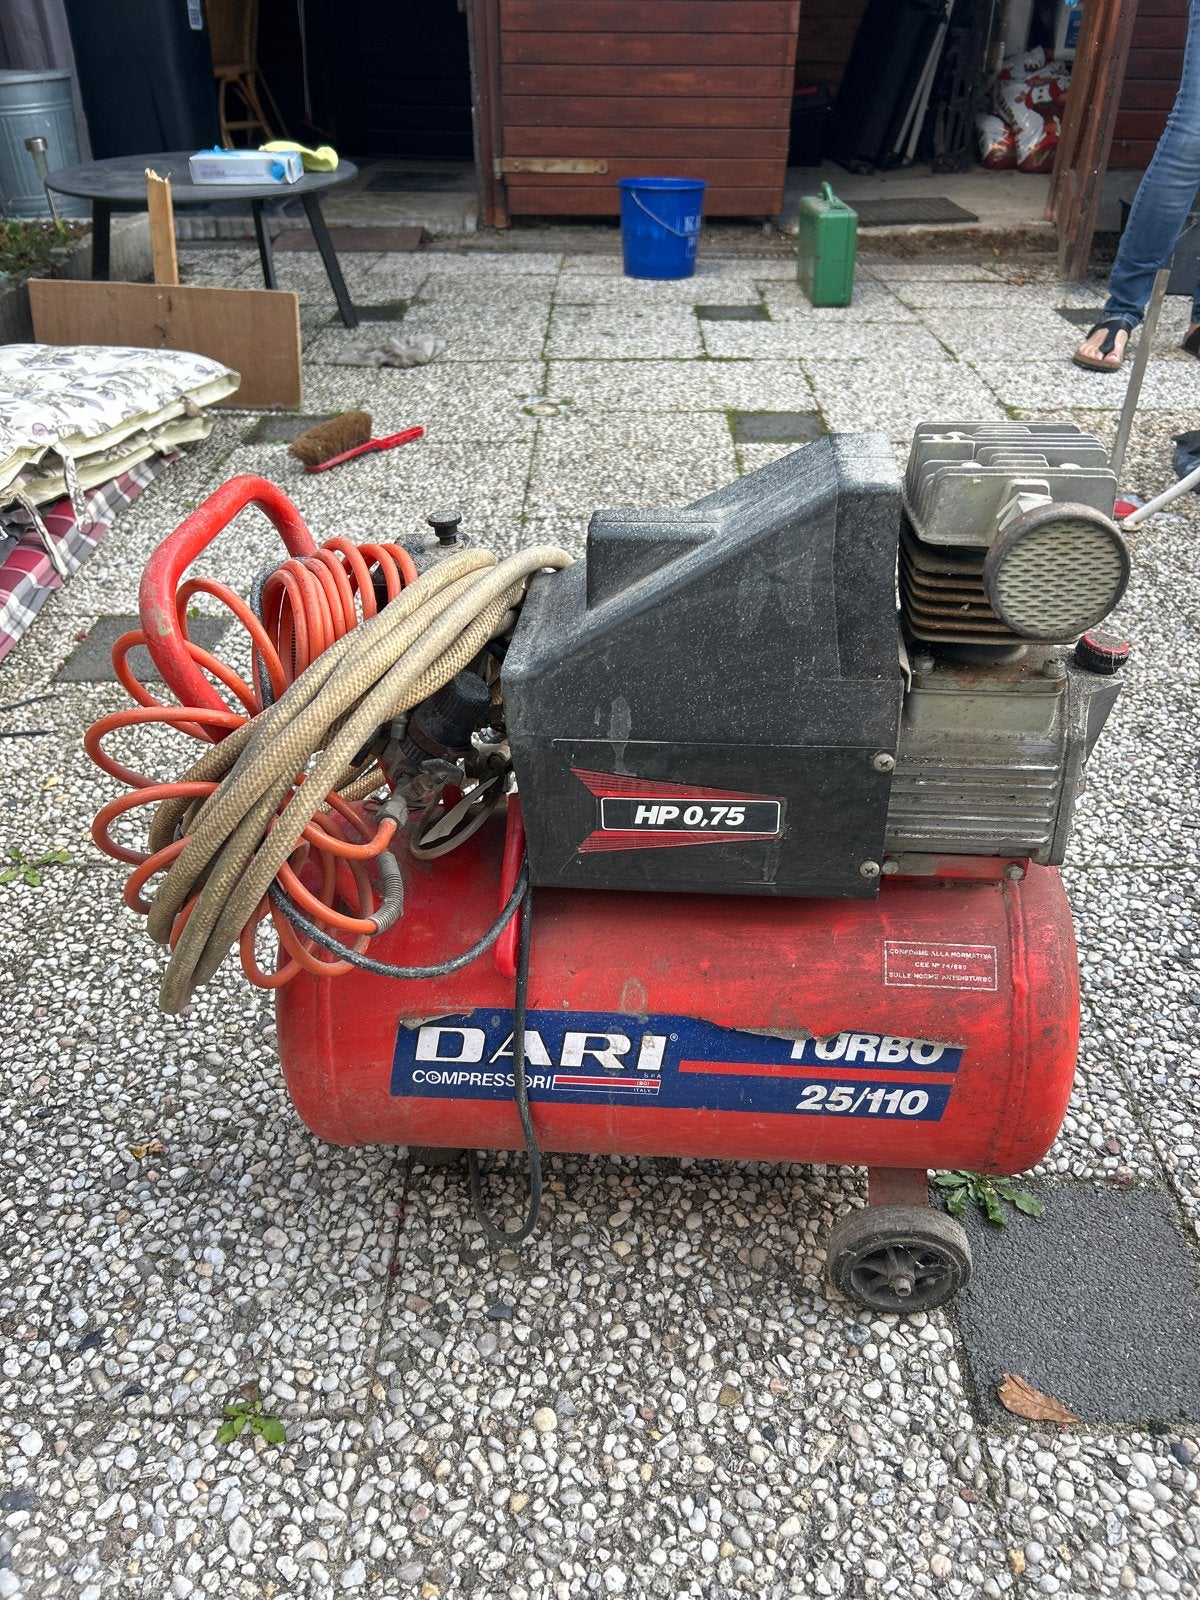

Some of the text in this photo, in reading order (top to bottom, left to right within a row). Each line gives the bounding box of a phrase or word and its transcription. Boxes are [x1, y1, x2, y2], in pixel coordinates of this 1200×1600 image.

[634, 805, 746, 828] HP 0,75
[931, 950, 950, 958] ALLA
[950, 951, 993, 960] NORMATIVA
[888, 971, 912, 979] SULLE
[790, 1033, 945, 1065] TURBO
[796, 1084, 929, 1116] 25/110
